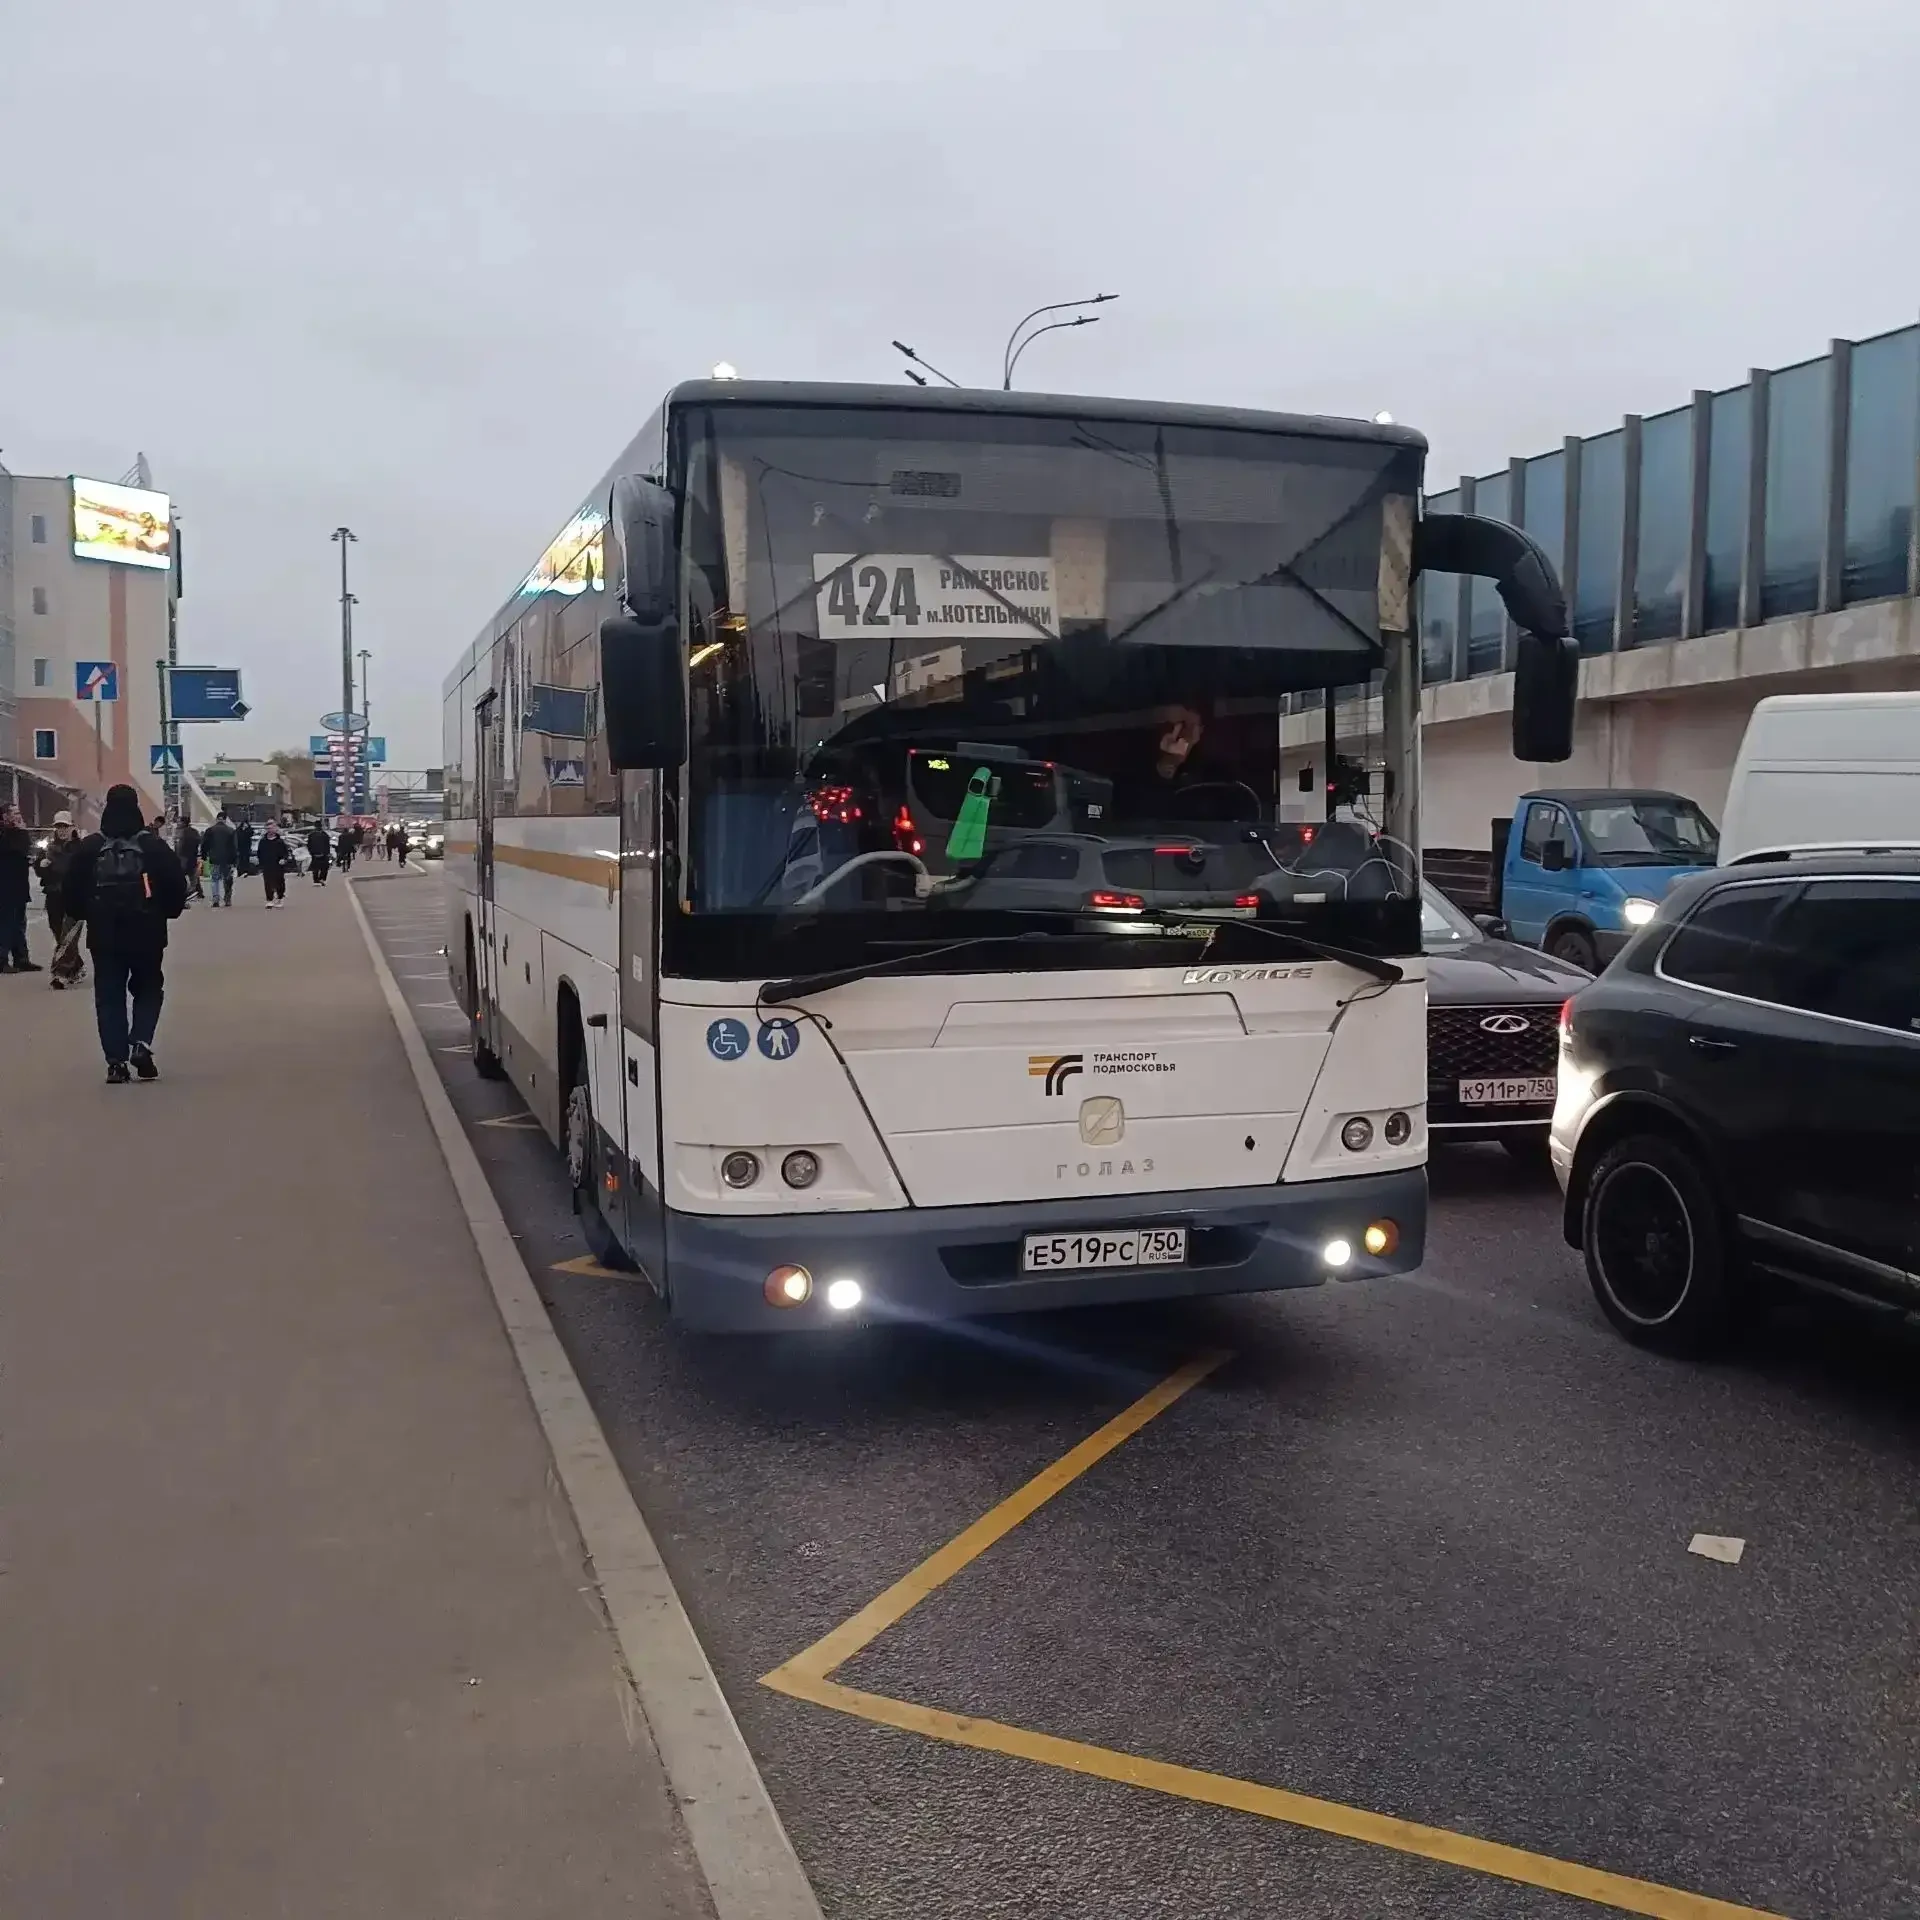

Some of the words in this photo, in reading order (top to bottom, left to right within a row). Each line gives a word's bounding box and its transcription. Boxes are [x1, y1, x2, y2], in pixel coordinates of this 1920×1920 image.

[828, 566, 921, 626] 424
[1182, 967, 1313, 985] VOYAGE
[1093, 1052, 1157, 1062] ТРАНСПОРТ
[1093, 1063, 1176, 1074] ПОДМОСКОВЬЯ
[1056, 1158, 1155, 1179] ГОЛАЗ
[1141, 1231, 1179, 1253] 750
[1148, 1252, 1168, 1261] RUS
